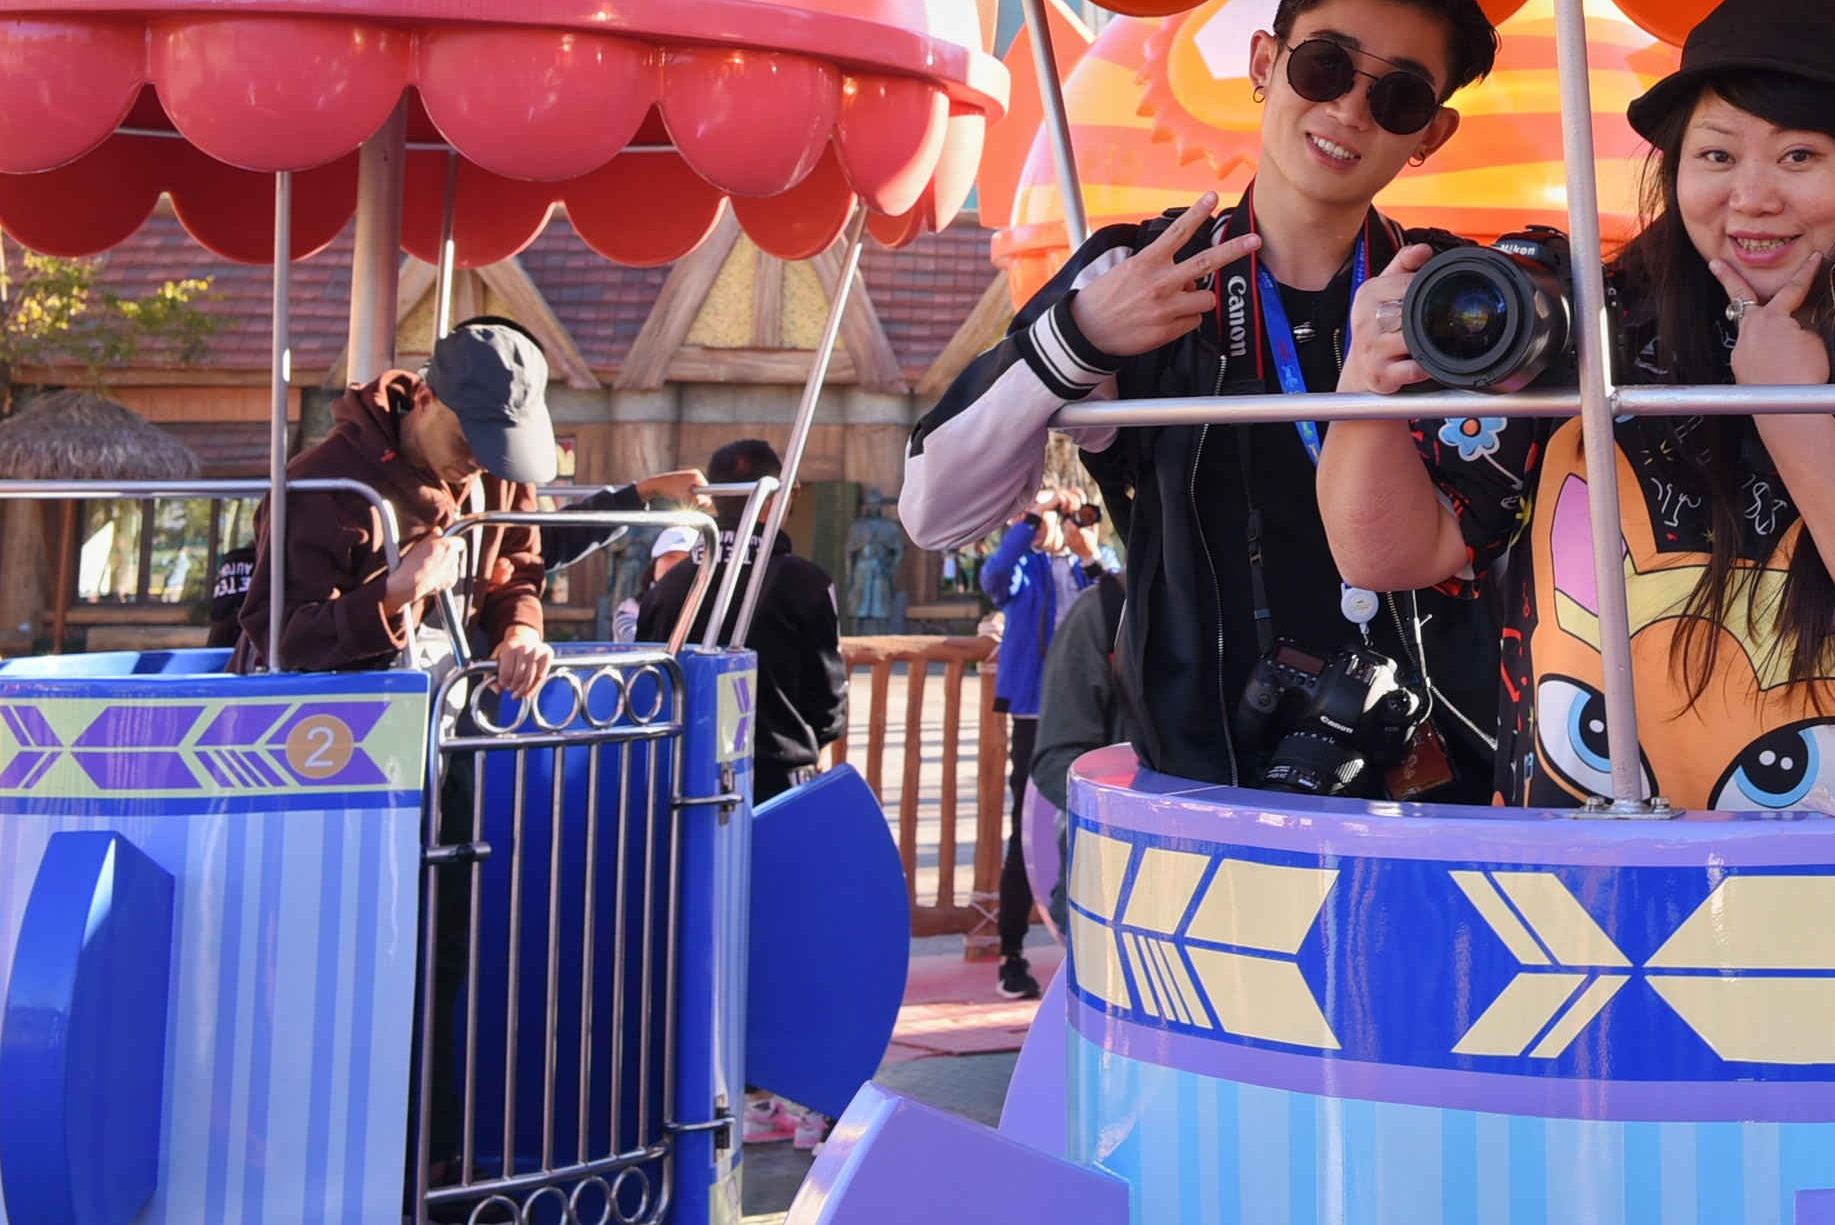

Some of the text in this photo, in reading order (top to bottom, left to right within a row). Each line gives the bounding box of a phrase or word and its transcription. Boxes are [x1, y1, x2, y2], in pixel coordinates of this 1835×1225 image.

[1500, 243, 1536, 255] Nikon
[1228, 275, 1247, 356] Canon
[1319, 715, 1353, 733] Canon
[304, 726, 334, 768] 2
